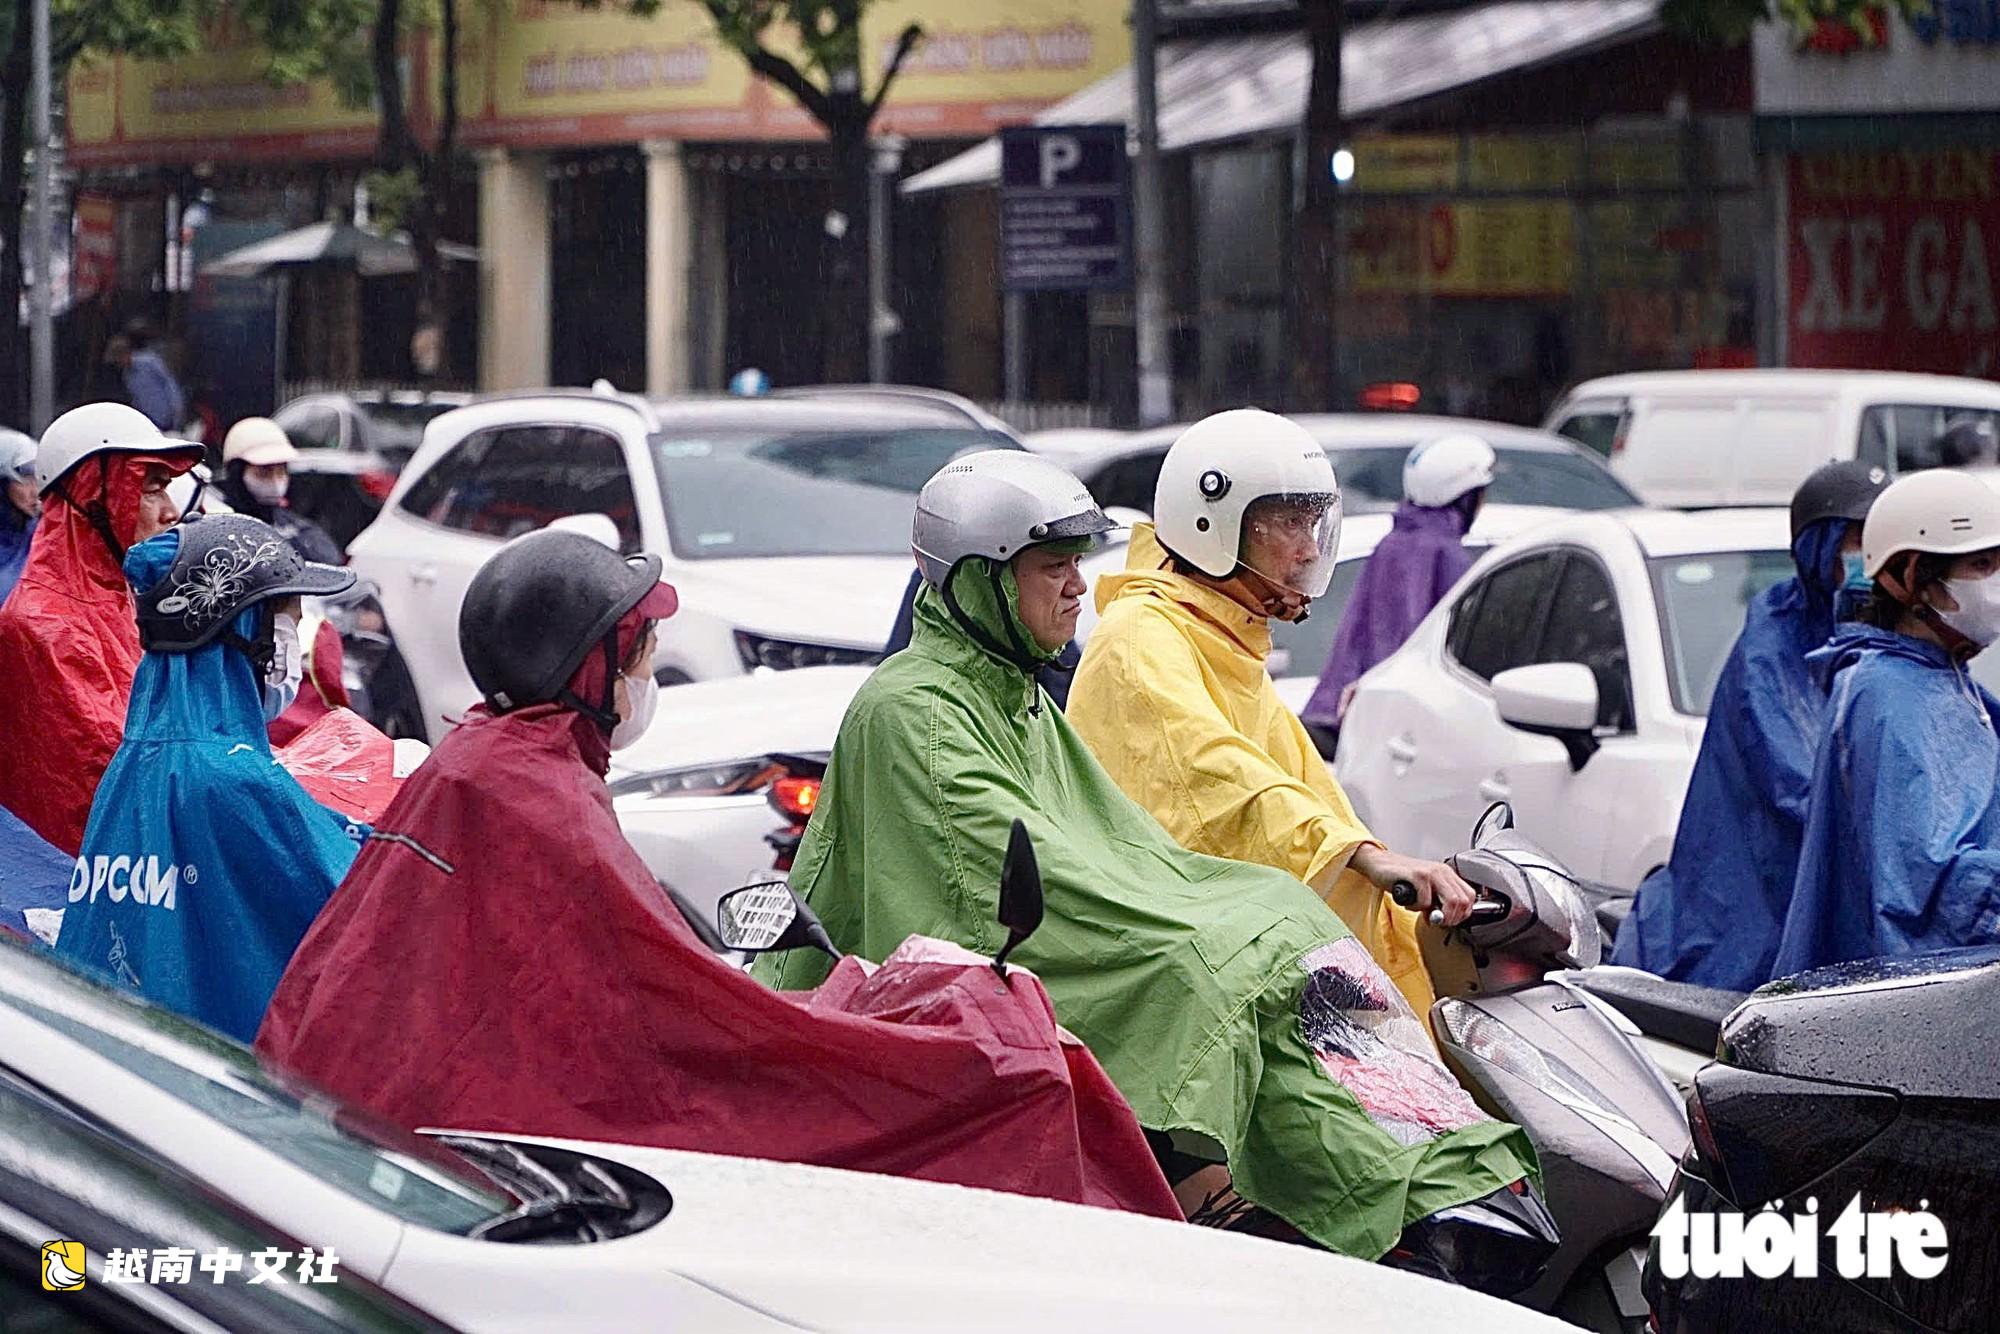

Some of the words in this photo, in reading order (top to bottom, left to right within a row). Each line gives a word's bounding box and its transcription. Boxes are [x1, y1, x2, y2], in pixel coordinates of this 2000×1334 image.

[1040, 134, 1082, 190] P
[1799, 216, 1887, 332] XE
[1905, 214, 1998, 333] GA
